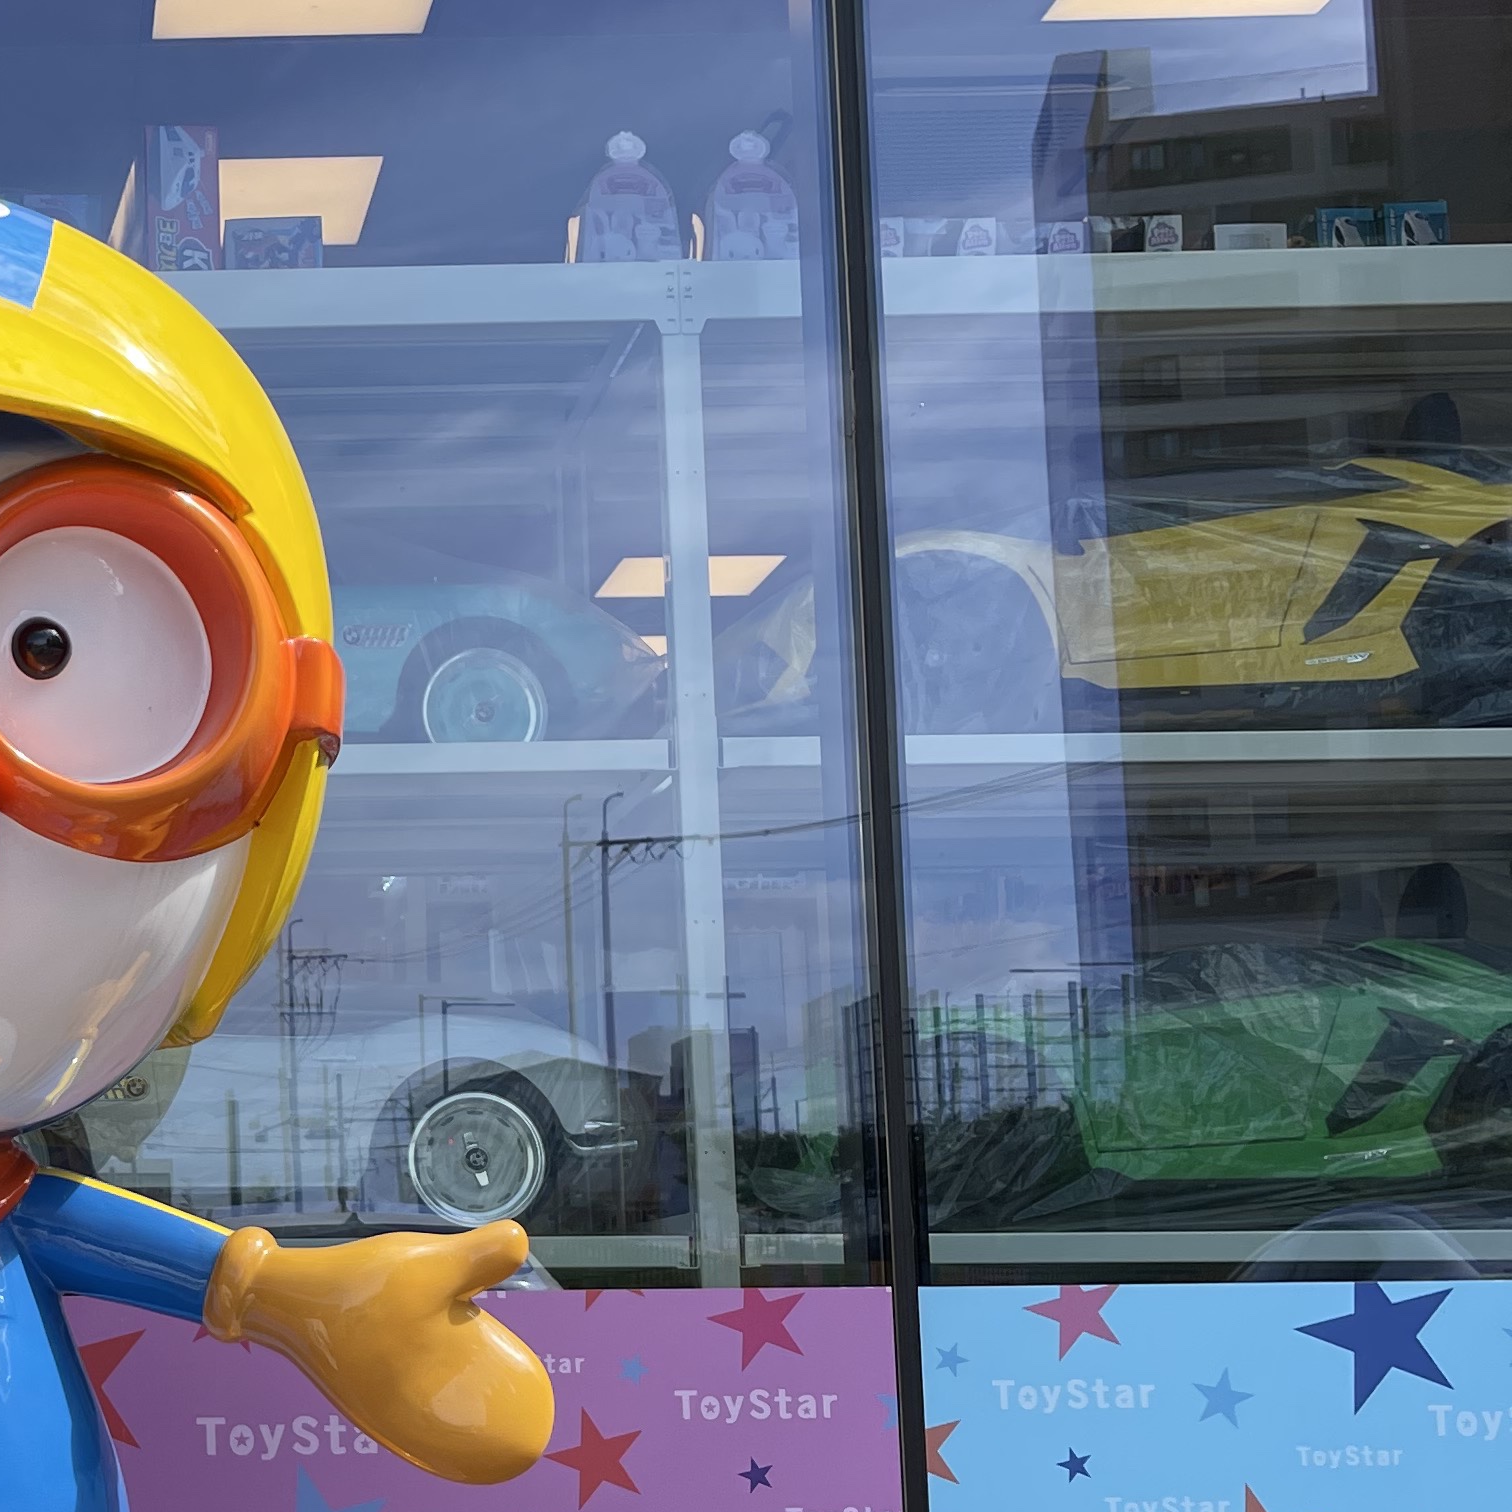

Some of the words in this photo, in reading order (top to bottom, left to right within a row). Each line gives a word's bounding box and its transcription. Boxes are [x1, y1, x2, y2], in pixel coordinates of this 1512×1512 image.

[675, 1388, 838, 1425] ToyStar
[992, 1378, 1156, 1414] ToyStar
[1427, 1404, 1512, 1441] Toy
[1296, 1445, 1404, 1469] ToyStar
